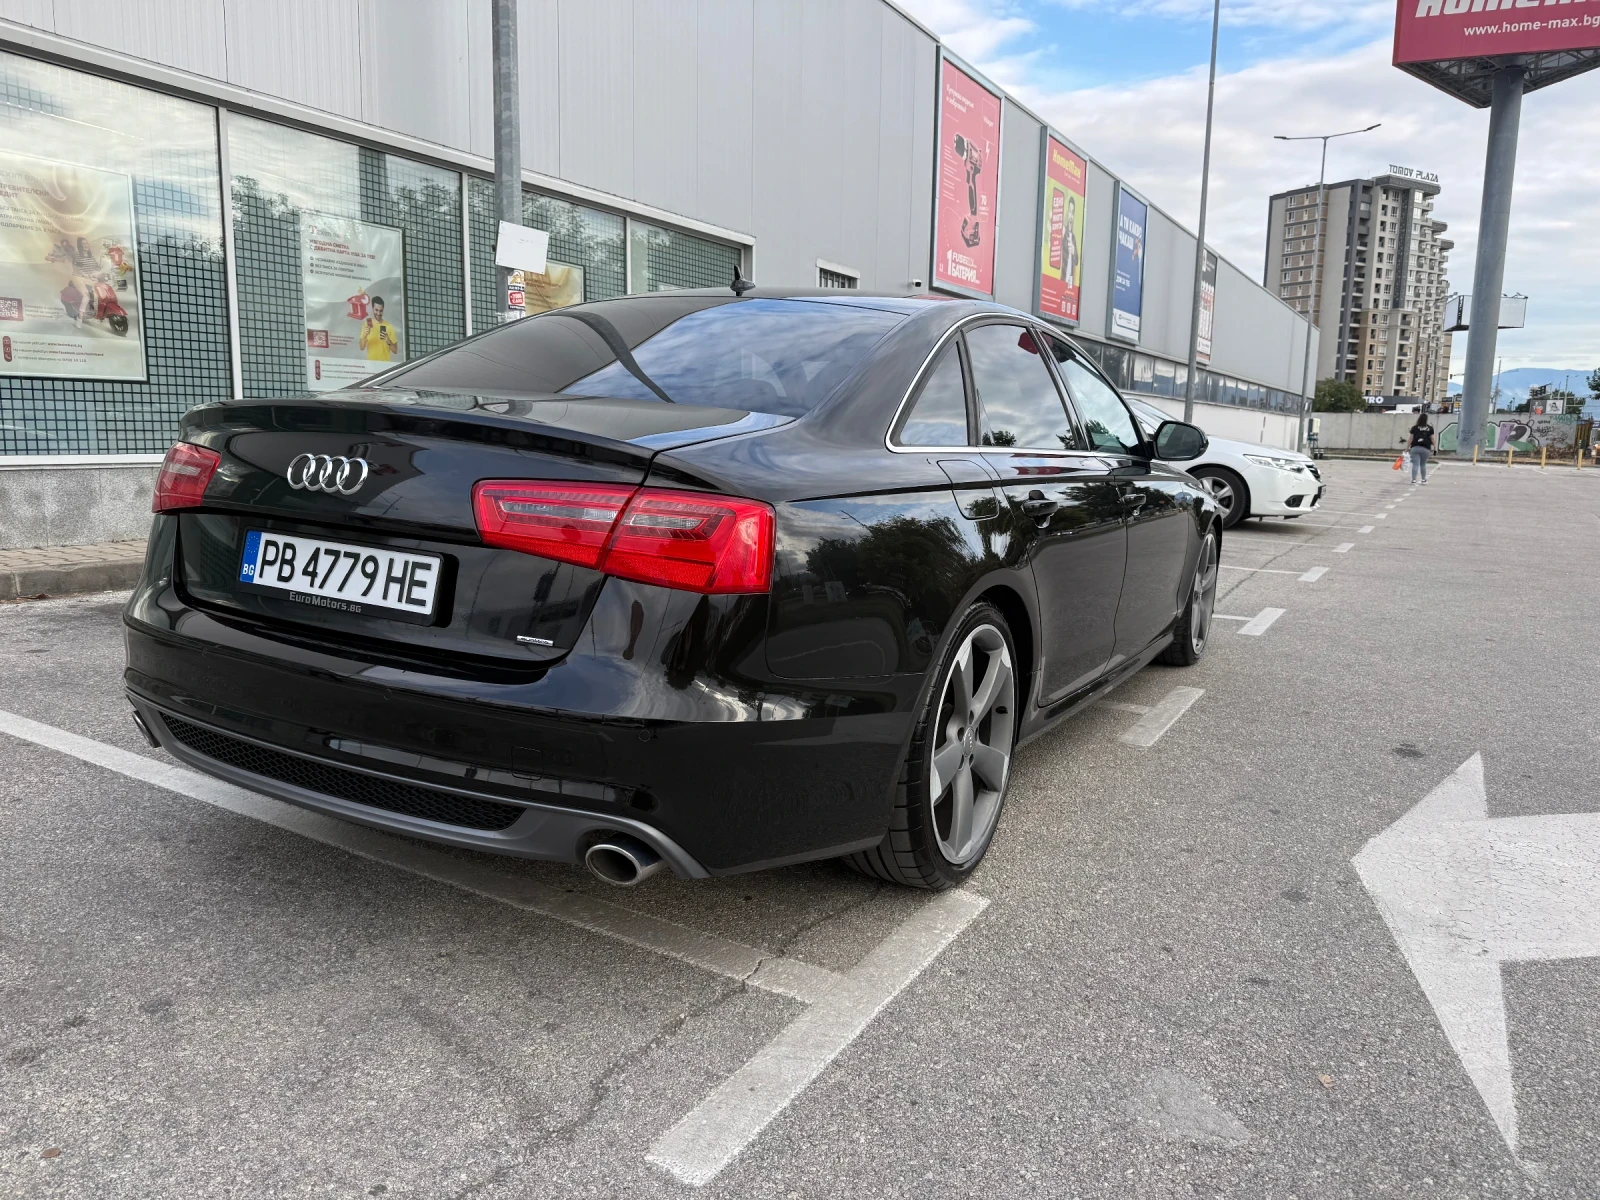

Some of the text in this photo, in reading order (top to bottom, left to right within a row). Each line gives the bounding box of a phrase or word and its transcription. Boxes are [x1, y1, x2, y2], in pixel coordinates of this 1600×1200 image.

[1463, 14, 1600, 36] www.home-max.bg
[1389, 164, 1439, 183] TOMOV PLAZA
[243, 563, 255, 577] BG
[259, 539, 432, 607] PB 4779 HE
